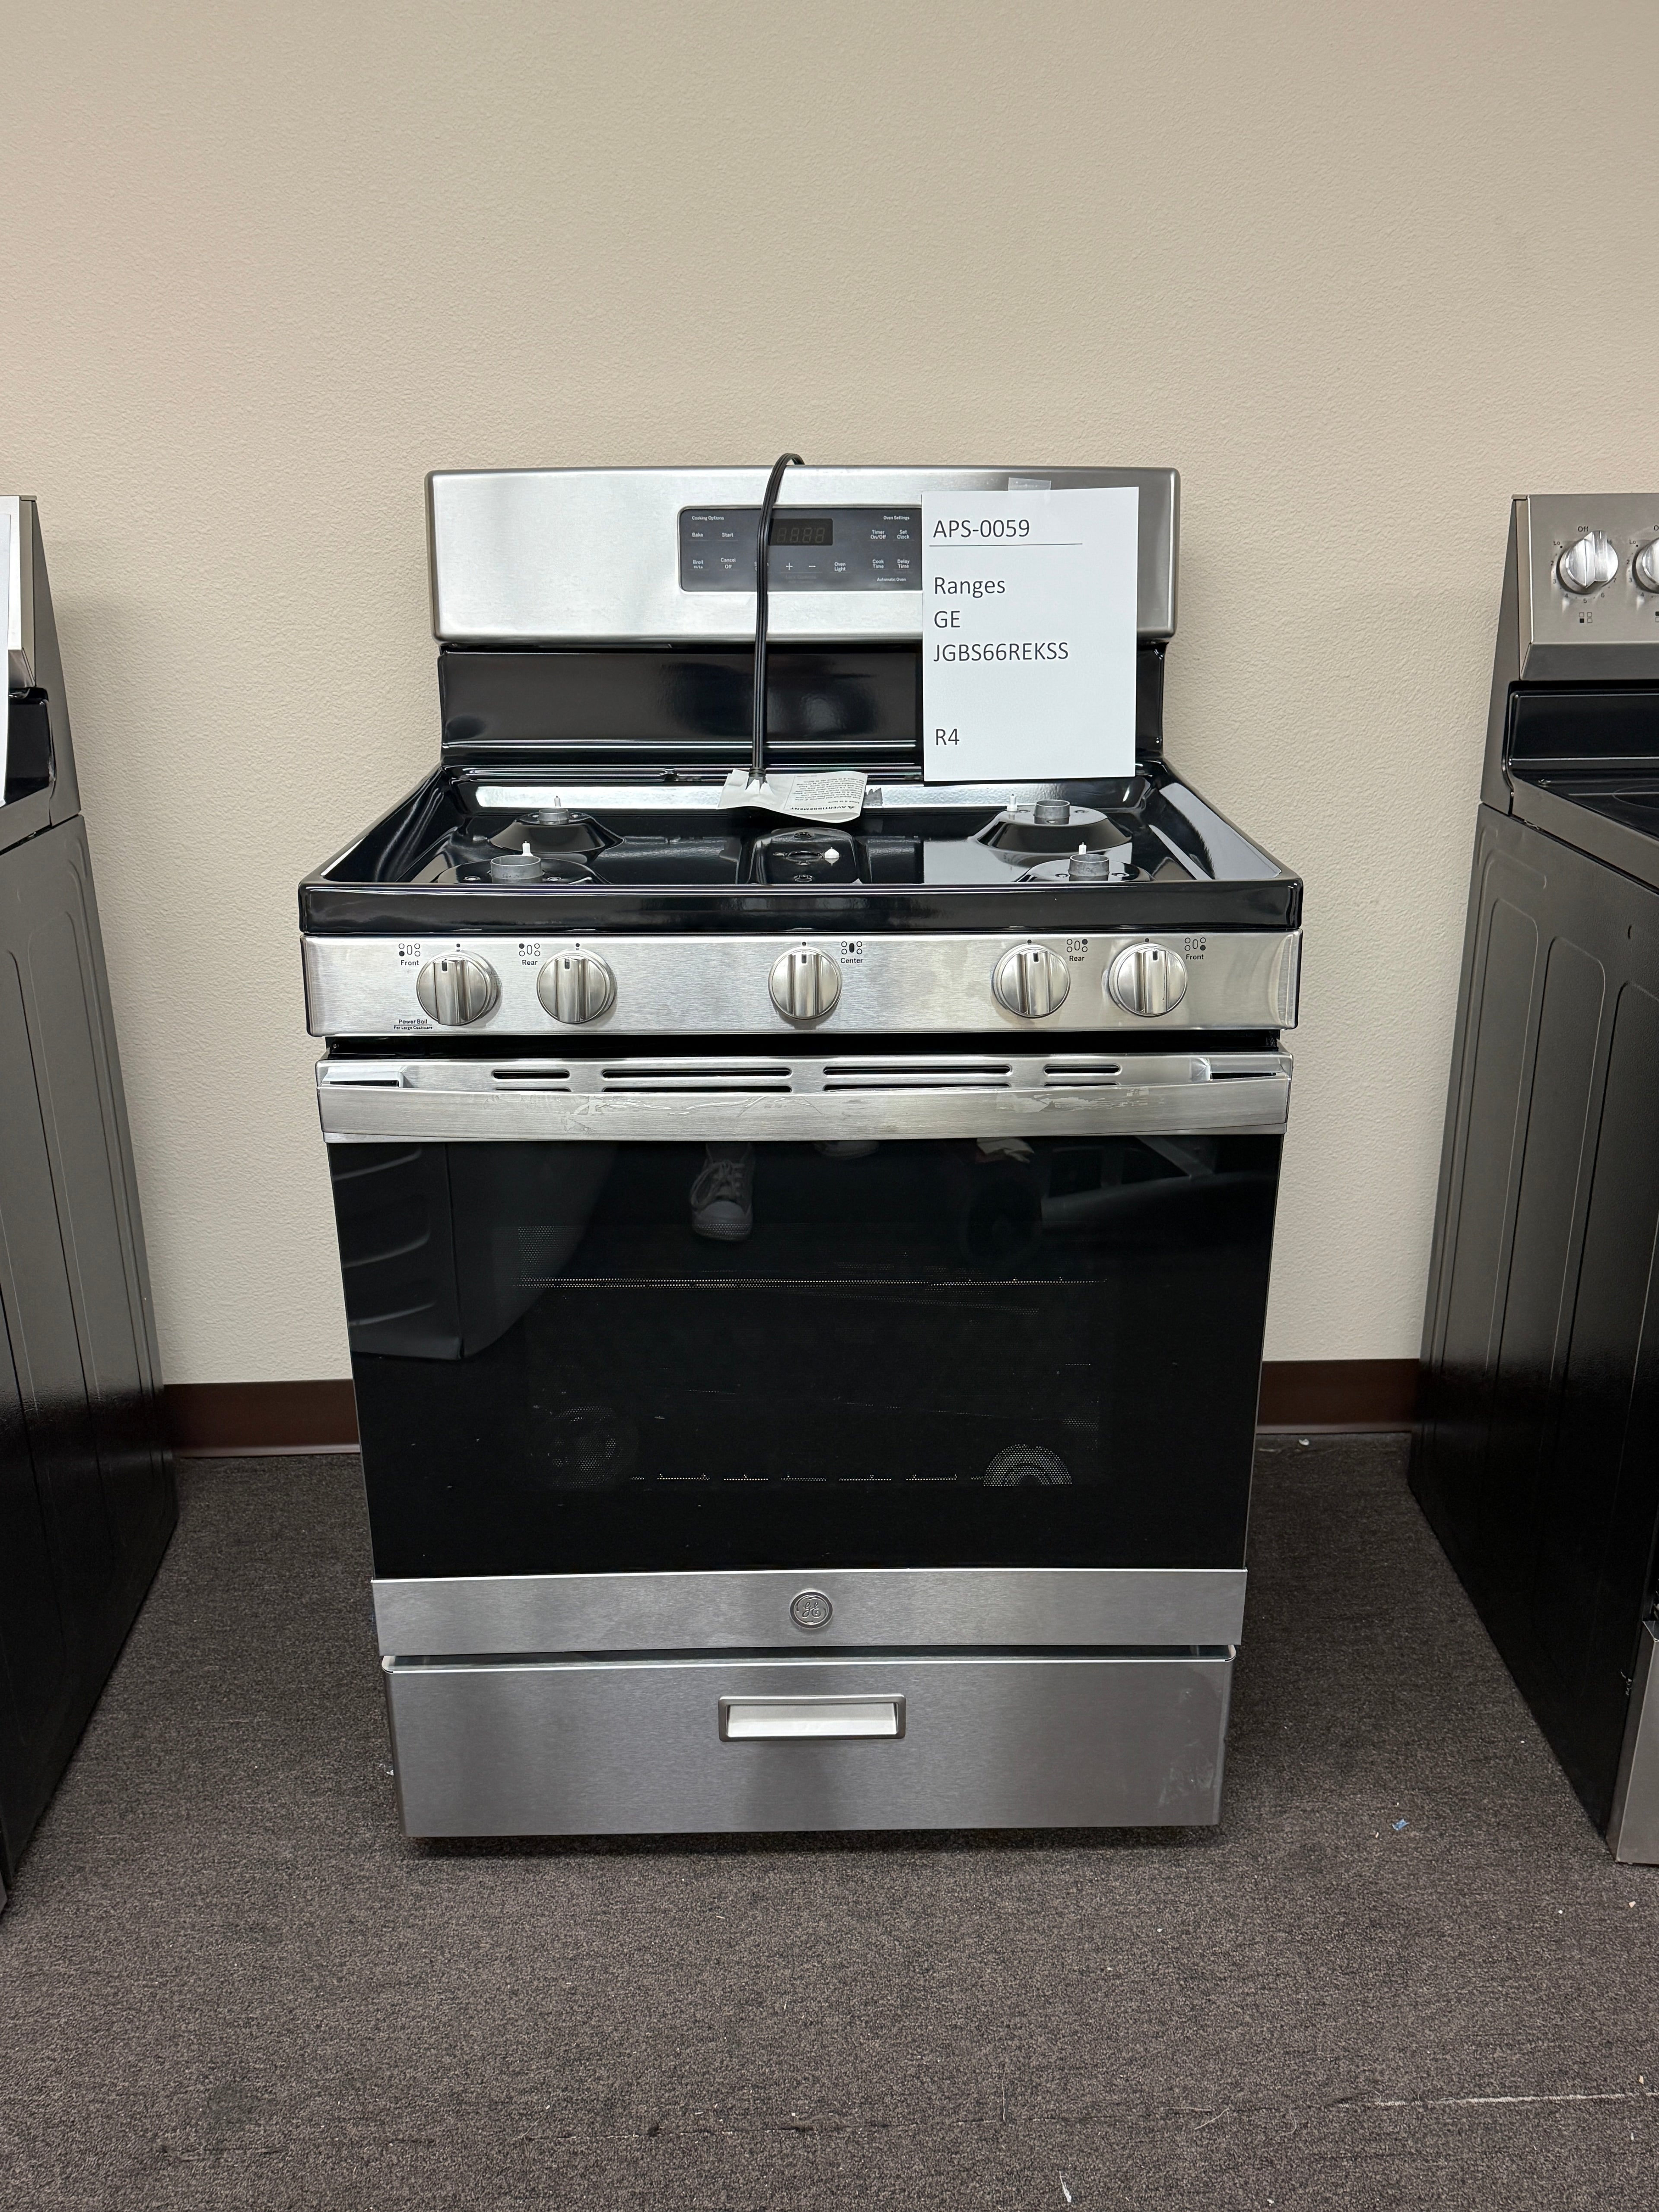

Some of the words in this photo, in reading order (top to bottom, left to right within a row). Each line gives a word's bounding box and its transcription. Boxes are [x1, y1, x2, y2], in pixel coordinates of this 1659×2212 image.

[933, 519, 1030, 538] APS-0059
[934, 577, 1006, 598] Ranges
[934, 610, 961, 629] GE
[933, 642, 1069, 662] JGBS66REKSS
[935, 728, 960, 746] R4
